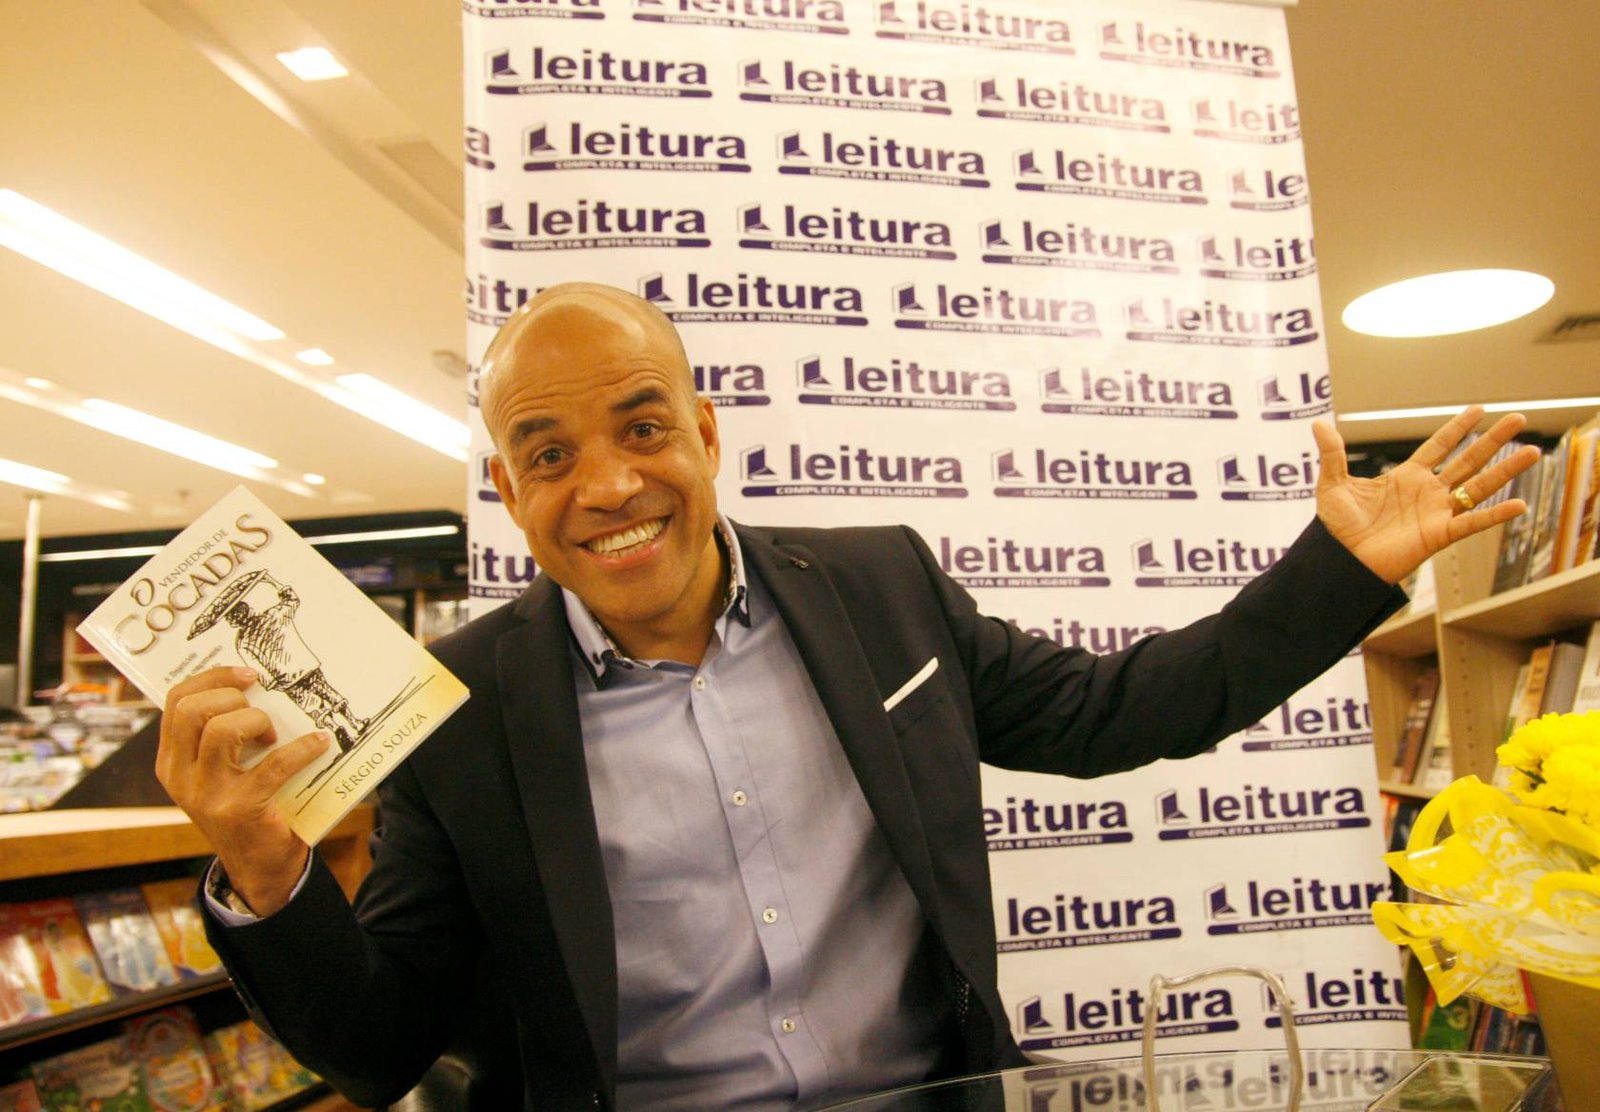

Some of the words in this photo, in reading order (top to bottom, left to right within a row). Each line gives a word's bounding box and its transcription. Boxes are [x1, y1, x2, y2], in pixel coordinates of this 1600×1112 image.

[917, 2, 1071, 43] leitura
[1135, 22, 1274, 67] leitura
[533, 47, 707, 85] leitura
[784, 60, 947, 102] leitura
[1017, 79, 1166, 121] leitura
[571, 122, 746, 158] leitura
[823, 132, 985, 174] leitura
[1055, 150, 1204, 192] leitura
[528, 200, 705, 235] leitura
[785, 204, 951, 246] leitura
[1023, 220, 1175, 262] leitura
[687, 273, 863, 312] leitura
[937, 284, 1096, 325] leitura
[1163, 298, 1313, 334] leitura
[844, 357, 1011, 397] leitura
[1081, 367, 1233, 405] leitura
[830, 396, 896, 407] COMPLETA
[790, 444, 963, 483] leitura
[1035, 449, 1192, 485] leitura
[776, 487, 844, 496] COMPLETA
[860, 488, 937, 496] INTELIGENTE
[1024, 489, 1086, 498] COMPLETA
[159, 541, 215, 589] VENDEDOR
[213, 528, 229, 546] DE
[940, 537, 1105, 573] leitura
[114, 513, 273, 656] COCADAS
[334, 752, 384, 800] SÉRGIO
[384, 712, 428, 753] SOUZA
[1199, 785, 1365, 823] leitura
[1188, 826, 1252, 838] COMPLETA
[1008, 894, 1176, 936] leitura
[1237, 920, 1300, 932] COMPLETA
[1076, 932, 1150, 944] INTELIGENTE
[1296, 1013, 1362, 1024] COMPLETA
[1051, 1034, 1118, 1048] COMPLETA
